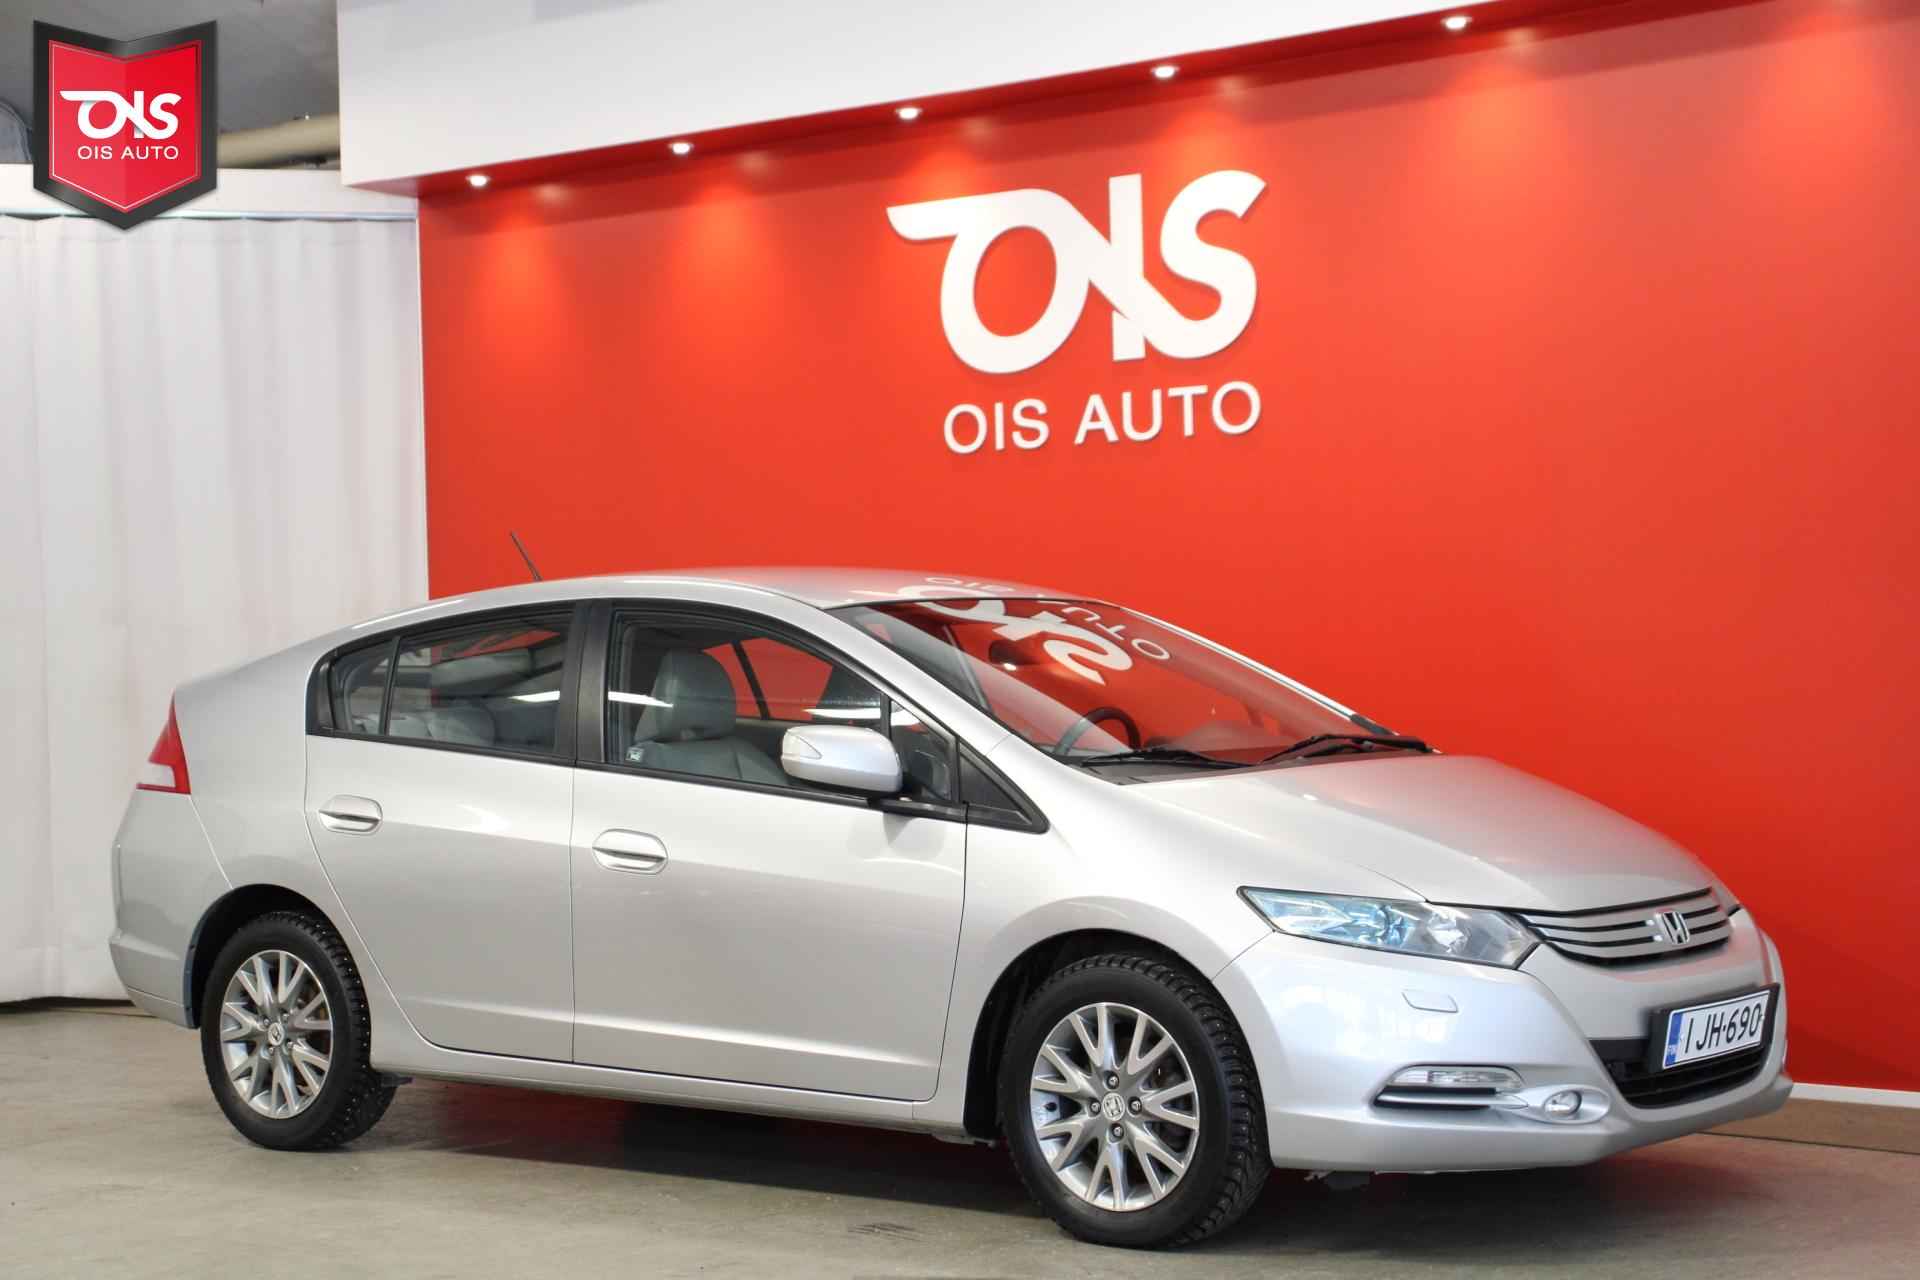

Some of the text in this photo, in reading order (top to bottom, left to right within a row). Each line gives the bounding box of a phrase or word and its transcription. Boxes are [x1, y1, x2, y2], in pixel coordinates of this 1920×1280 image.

[943, 381, 1262, 454] OIS AUTO
[1684, 1002, 1762, 1054] IJH-690
